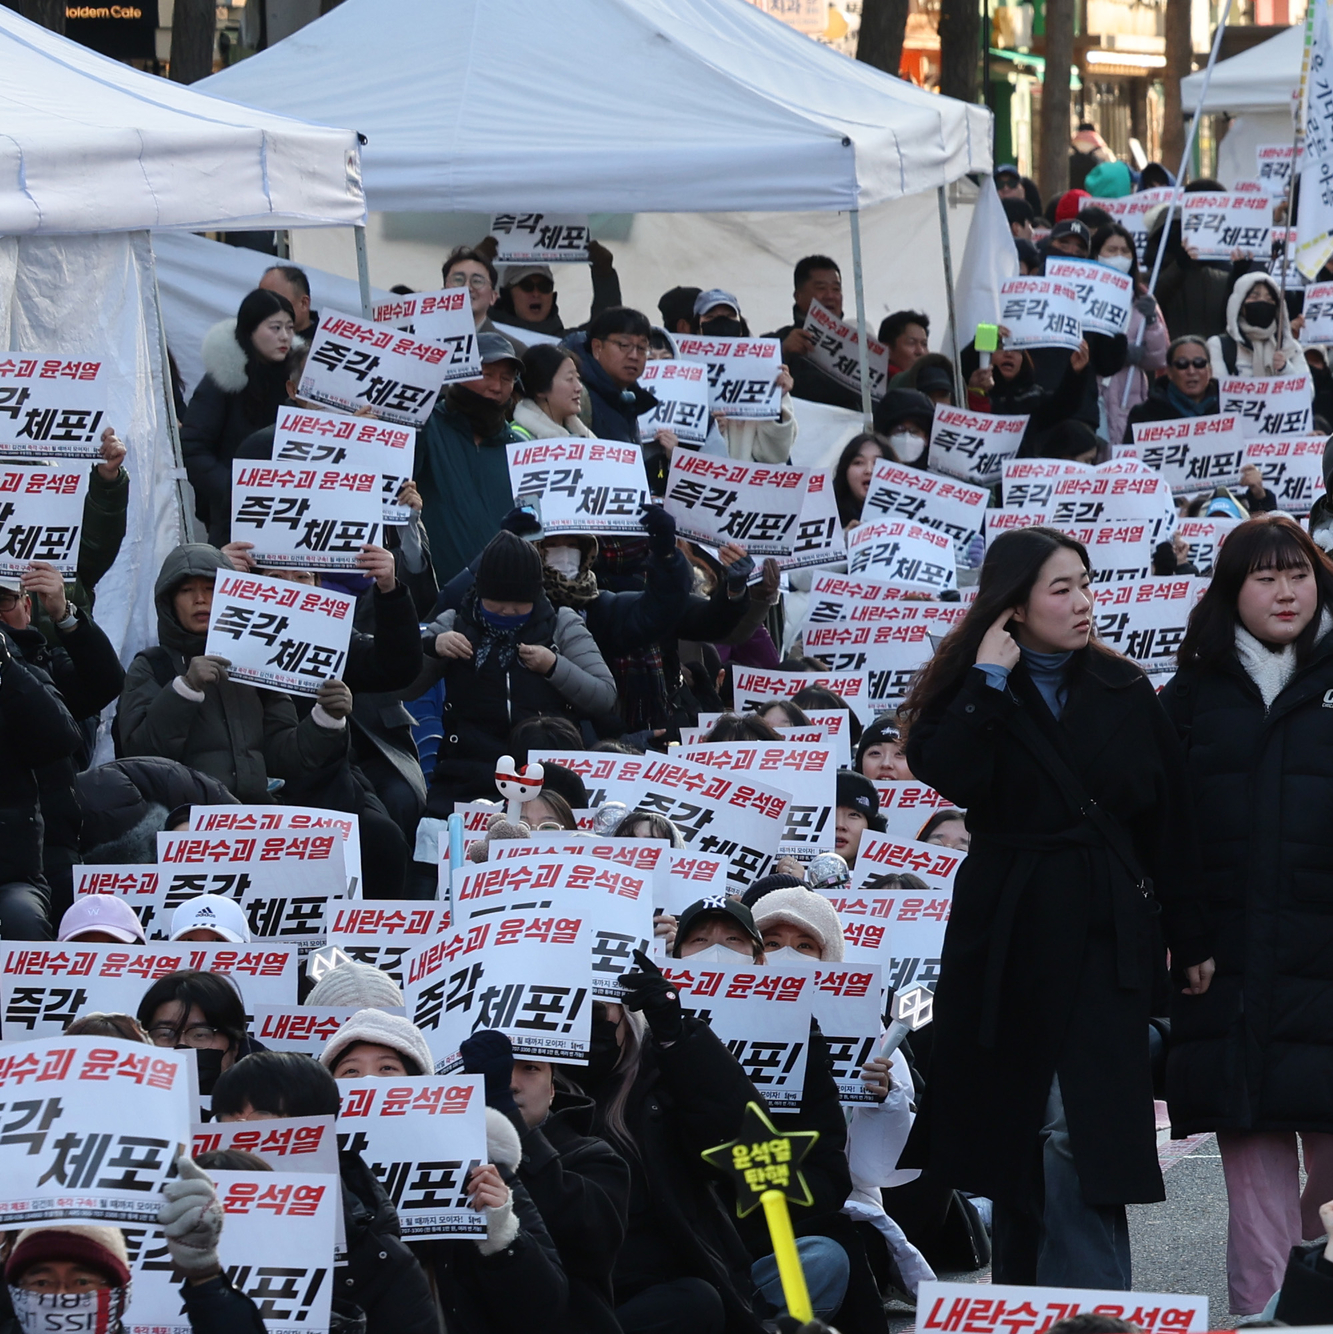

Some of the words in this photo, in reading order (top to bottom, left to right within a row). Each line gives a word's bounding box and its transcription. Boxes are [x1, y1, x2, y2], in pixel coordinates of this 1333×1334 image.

[513, 444, 585, 465] 내란수괴
[589, 445, 637, 464] 윤석열
[238, 469, 316, 488] 내란수괴
[320, 471, 375, 491] 윤석열
[514, 469, 583, 504] 즉각
[235, 496, 310, 530] 즉각
[295, 519, 379, 553] 체포!
[219, 578, 297, 607] 내란수괴
[300, 594, 350, 619] 윤석열
[213, 606, 289, 647] 즉각
[270, 639, 345, 680] 체포!
[702, 896, 726, 909] NY
[409, 921, 490, 983] 내란수괴
[495, 918, 581, 945] 윤석열
[413, 962, 484, 1030] 즉각
[471, 985, 587, 1036] 체포!
[732, 1138, 791, 1170] 윤석열
[744, 1163, 790, 1192] 탄핵
